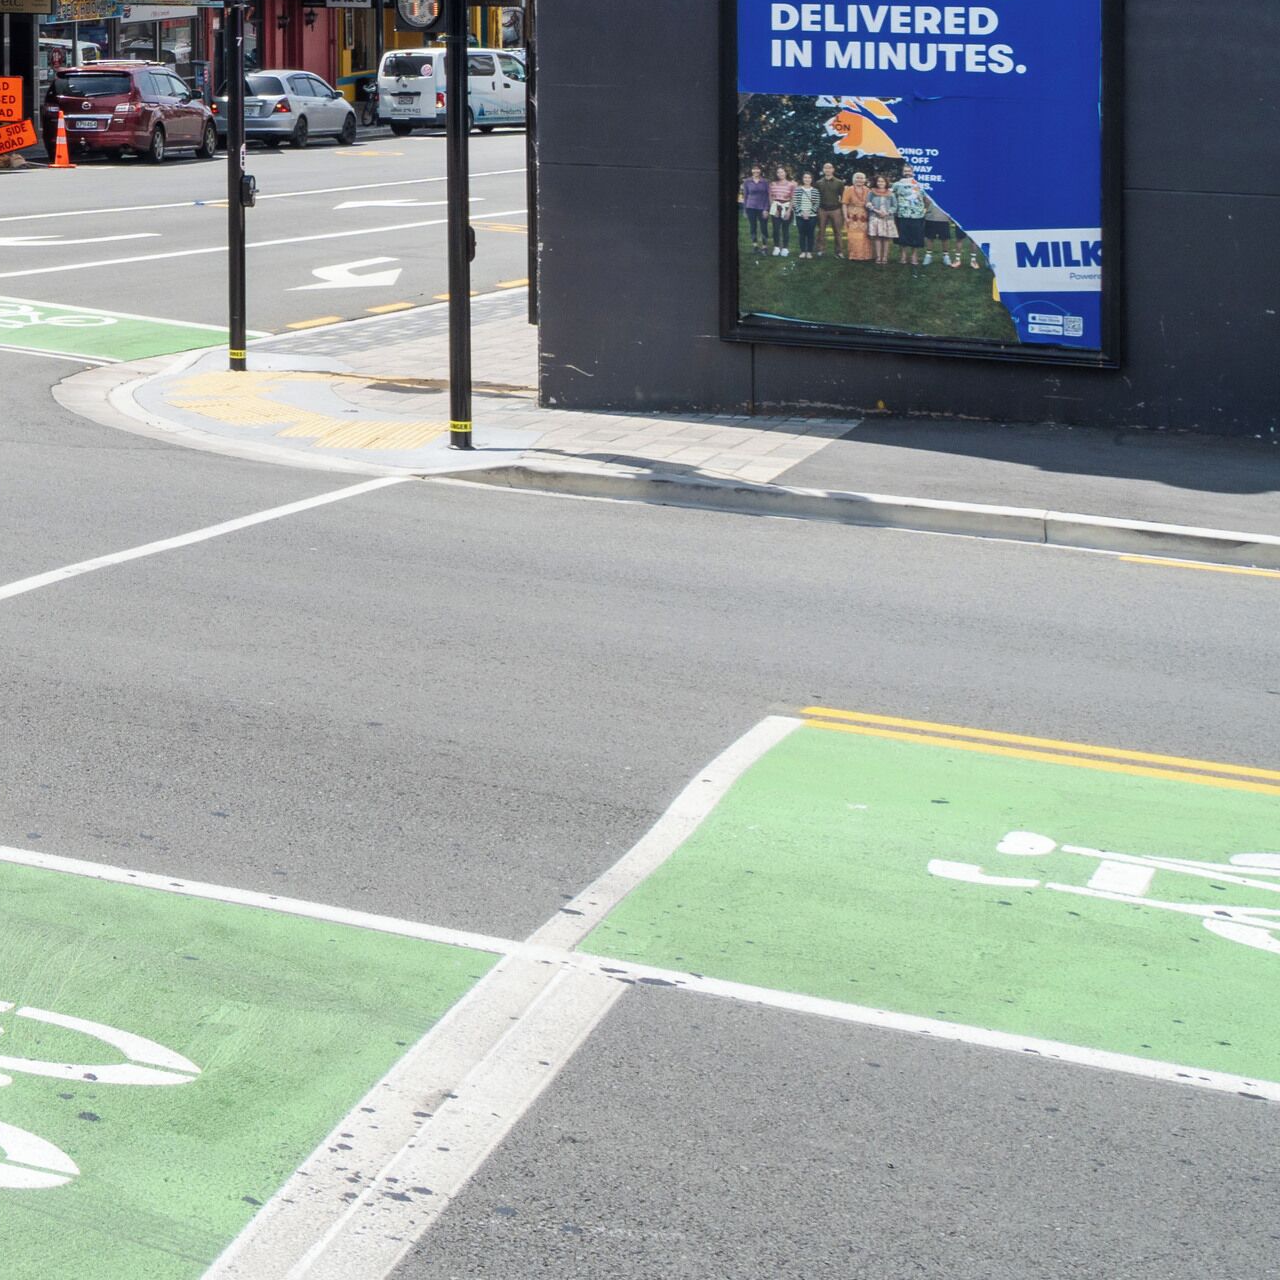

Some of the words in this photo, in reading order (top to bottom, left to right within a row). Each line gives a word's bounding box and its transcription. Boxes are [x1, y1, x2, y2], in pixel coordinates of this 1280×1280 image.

[771, 3, 999, 36] DELIVERED
[235, 36, 243, 47] 7
[771, 39, 813, 68] IN
[825, 40, 1027, 74] MINUTES.
[5, 123, 28, 137] SIDE
[832, 123, 851, 132] ON
[898, 147, 924, 156] OING
[925, 148, 939, 156] TO
[917, 174, 945, 182] HERE.
[1015, 240, 1102, 268] MILK
